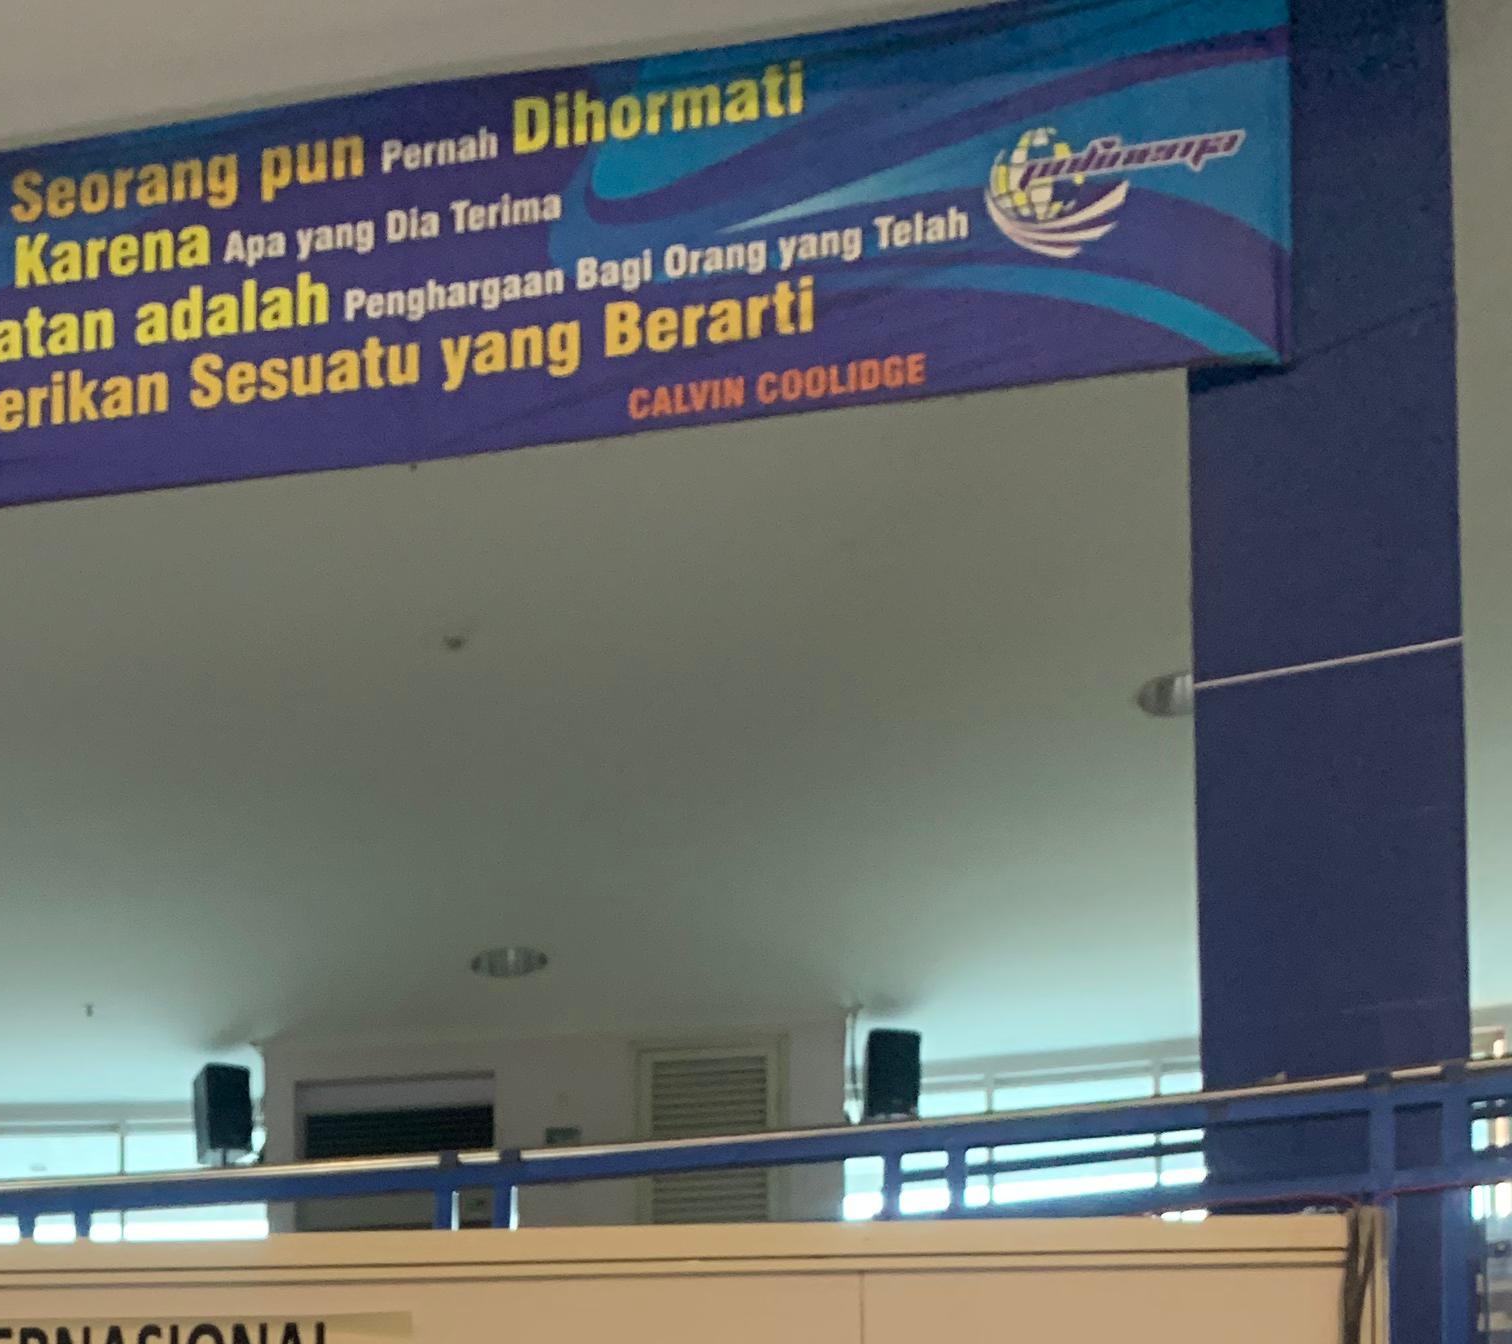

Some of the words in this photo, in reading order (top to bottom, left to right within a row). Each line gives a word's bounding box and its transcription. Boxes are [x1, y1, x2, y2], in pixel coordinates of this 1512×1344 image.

[10, 157, 238, 222] Seorang
[261, 134, 365, 199] pun
[382, 128, 499, 174] Pernah
[514, 60, 805, 155] Dihormati
[15, 221, 210, 288] Karena
[224, 225, 285, 268] Apa
[297, 218, 375, 263] yang
[385, 204, 441, 243] Dia
[450, 193, 561, 235] Terima
[136, 273, 329, 349] adalah
[344, 265, 564, 323] Penghargaan
[575, 251, 654, 297] Bagi
[663, 240, 767, 285] Orang
[778, 228, 861, 270] yang
[874, 207, 970, 250] Telah
[188, 344, 421, 411] Sesuatu
[442, 320, 581, 393] yang
[604, 276, 815, 358] Berarti
[627, 377, 745, 421] CALVIN
[756, 353, 926, 407] COOLIDGE
